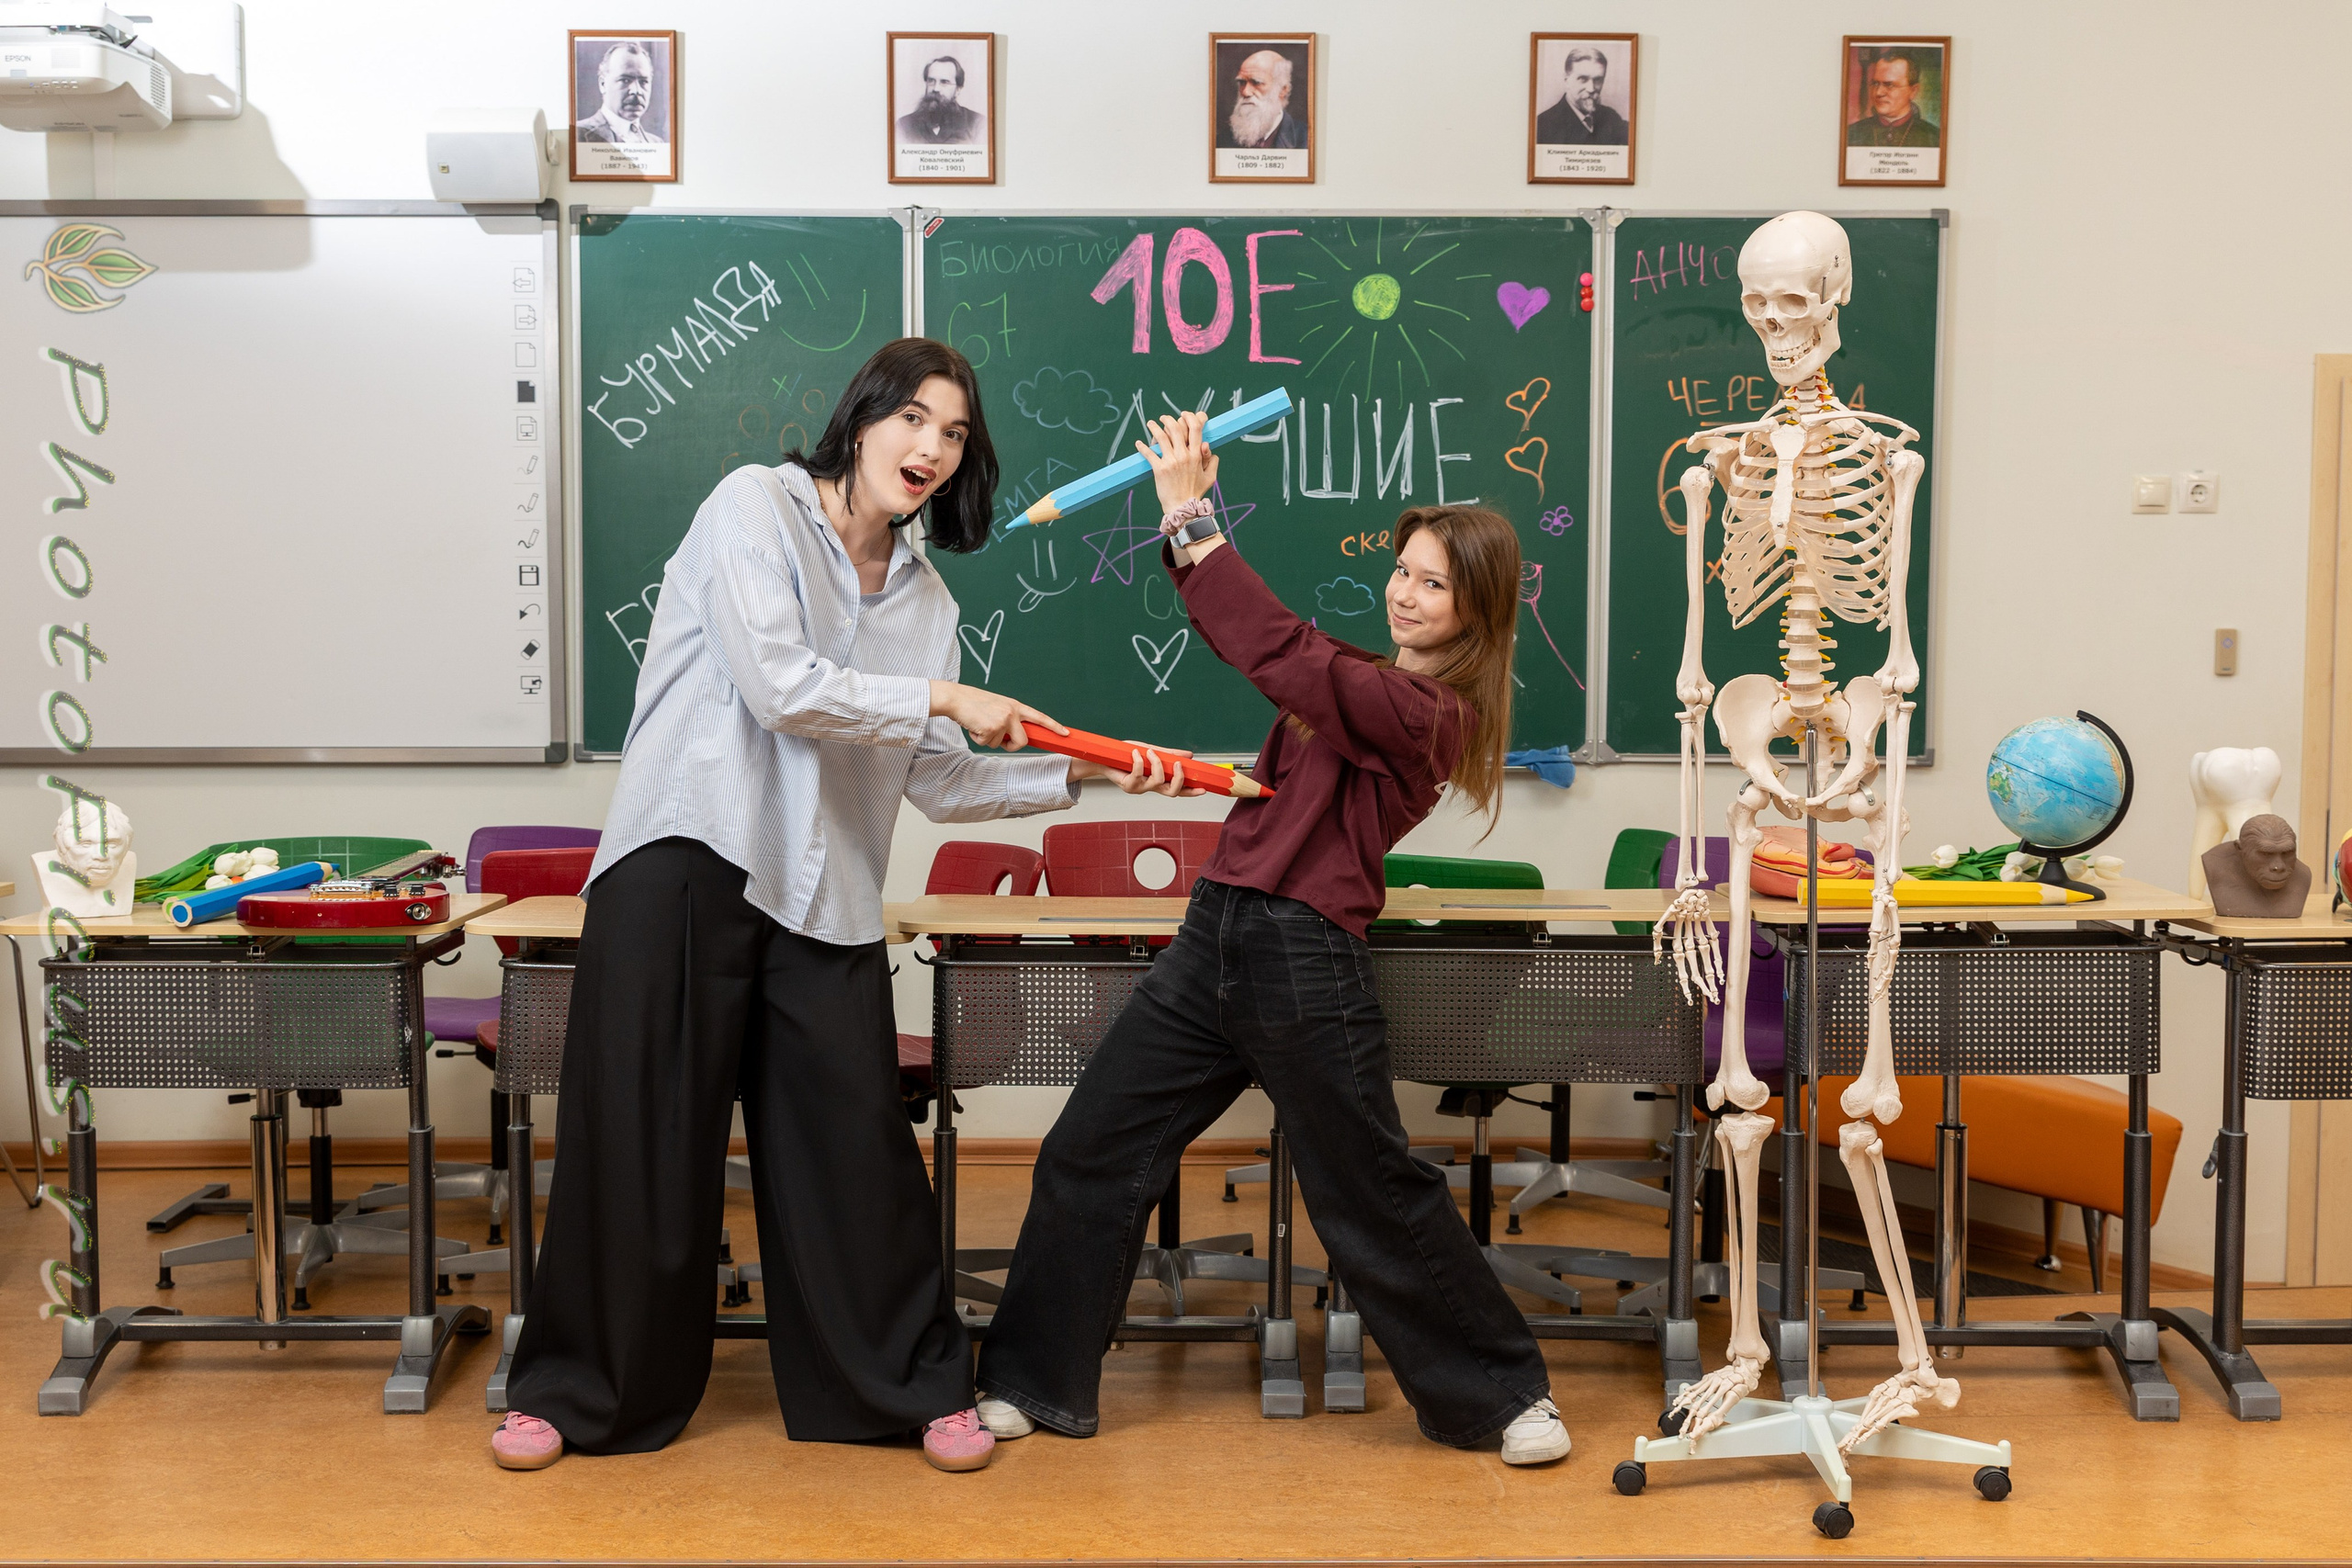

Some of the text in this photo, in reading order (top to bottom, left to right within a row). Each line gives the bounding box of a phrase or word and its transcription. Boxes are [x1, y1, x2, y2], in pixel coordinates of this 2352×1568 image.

[5, 54, 31, 62] EPSON
[1630, 242, 1739, 300] АНЧО
[587, 260, 782, 449] БУРМАЛДА
[948, 292, 1017, 369] 67
[972, 457, 1078, 554] ЕМГА
